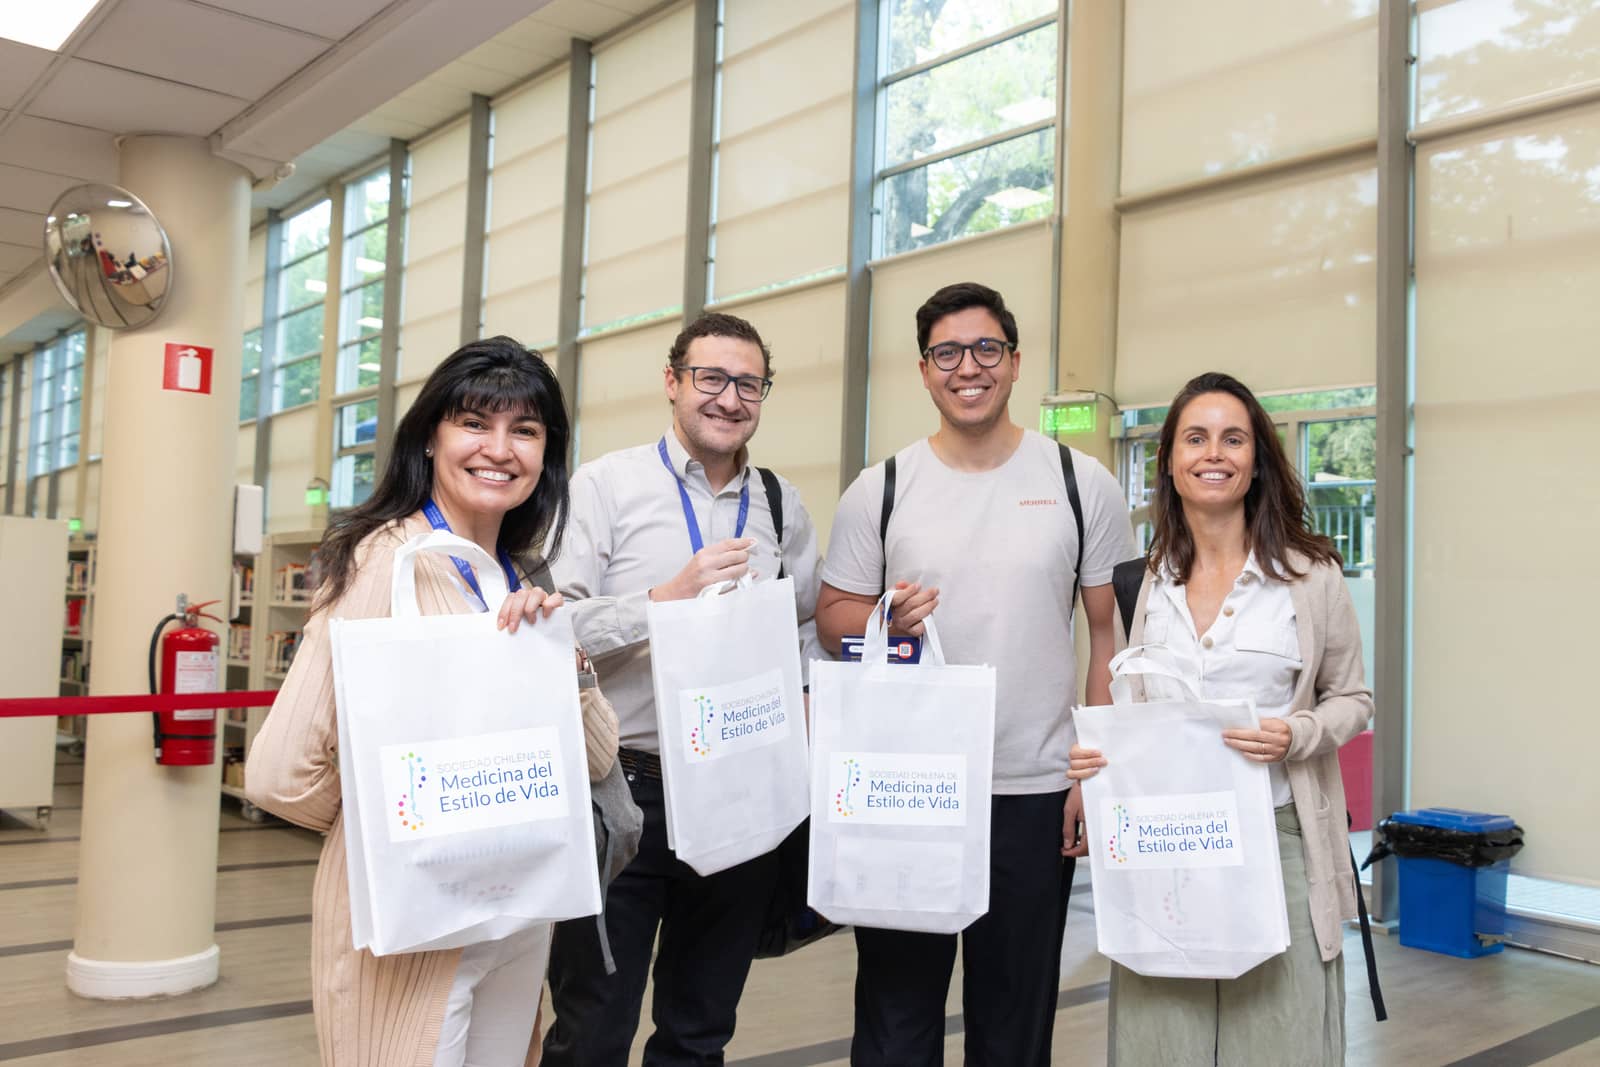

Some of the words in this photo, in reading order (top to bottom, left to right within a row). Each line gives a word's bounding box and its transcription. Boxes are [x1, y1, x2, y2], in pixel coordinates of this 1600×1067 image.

[723, 703, 771, 725] Medicina
[771, 696, 782, 711] del
[721, 725, 753, 741] Estilo
[755, 718, 768, 732] de
[769, 712, 786, 727] Vida
[436, 756, 491, 774] SOCIEDAD
[494, 751, 536, 767] CHILENA
[538, 749, 552, 760] DE
[441, 767, 524, 793] Medicina
[527, 761, 553, 780] del
[870, 780, 933, 794] Medicina
[936, 781, 957, 795] del
[439, 790, 491, 813] Estilo
[495, 787, 517, 805] de
[519, 781, 559, 800] Vida
[867, 794, 905, 809] Estilo
[908, 795, 925, 809] de
[928, 796, 960, 810] Vida
[1139, 822, 1203, 837] Medicina
[1206, 819, 1228, 835] del
[1137, 837, 1176, 853] Estilo
[1178, 838, 1197, 852] de
[1199, 836, 1233, 851] Vida
